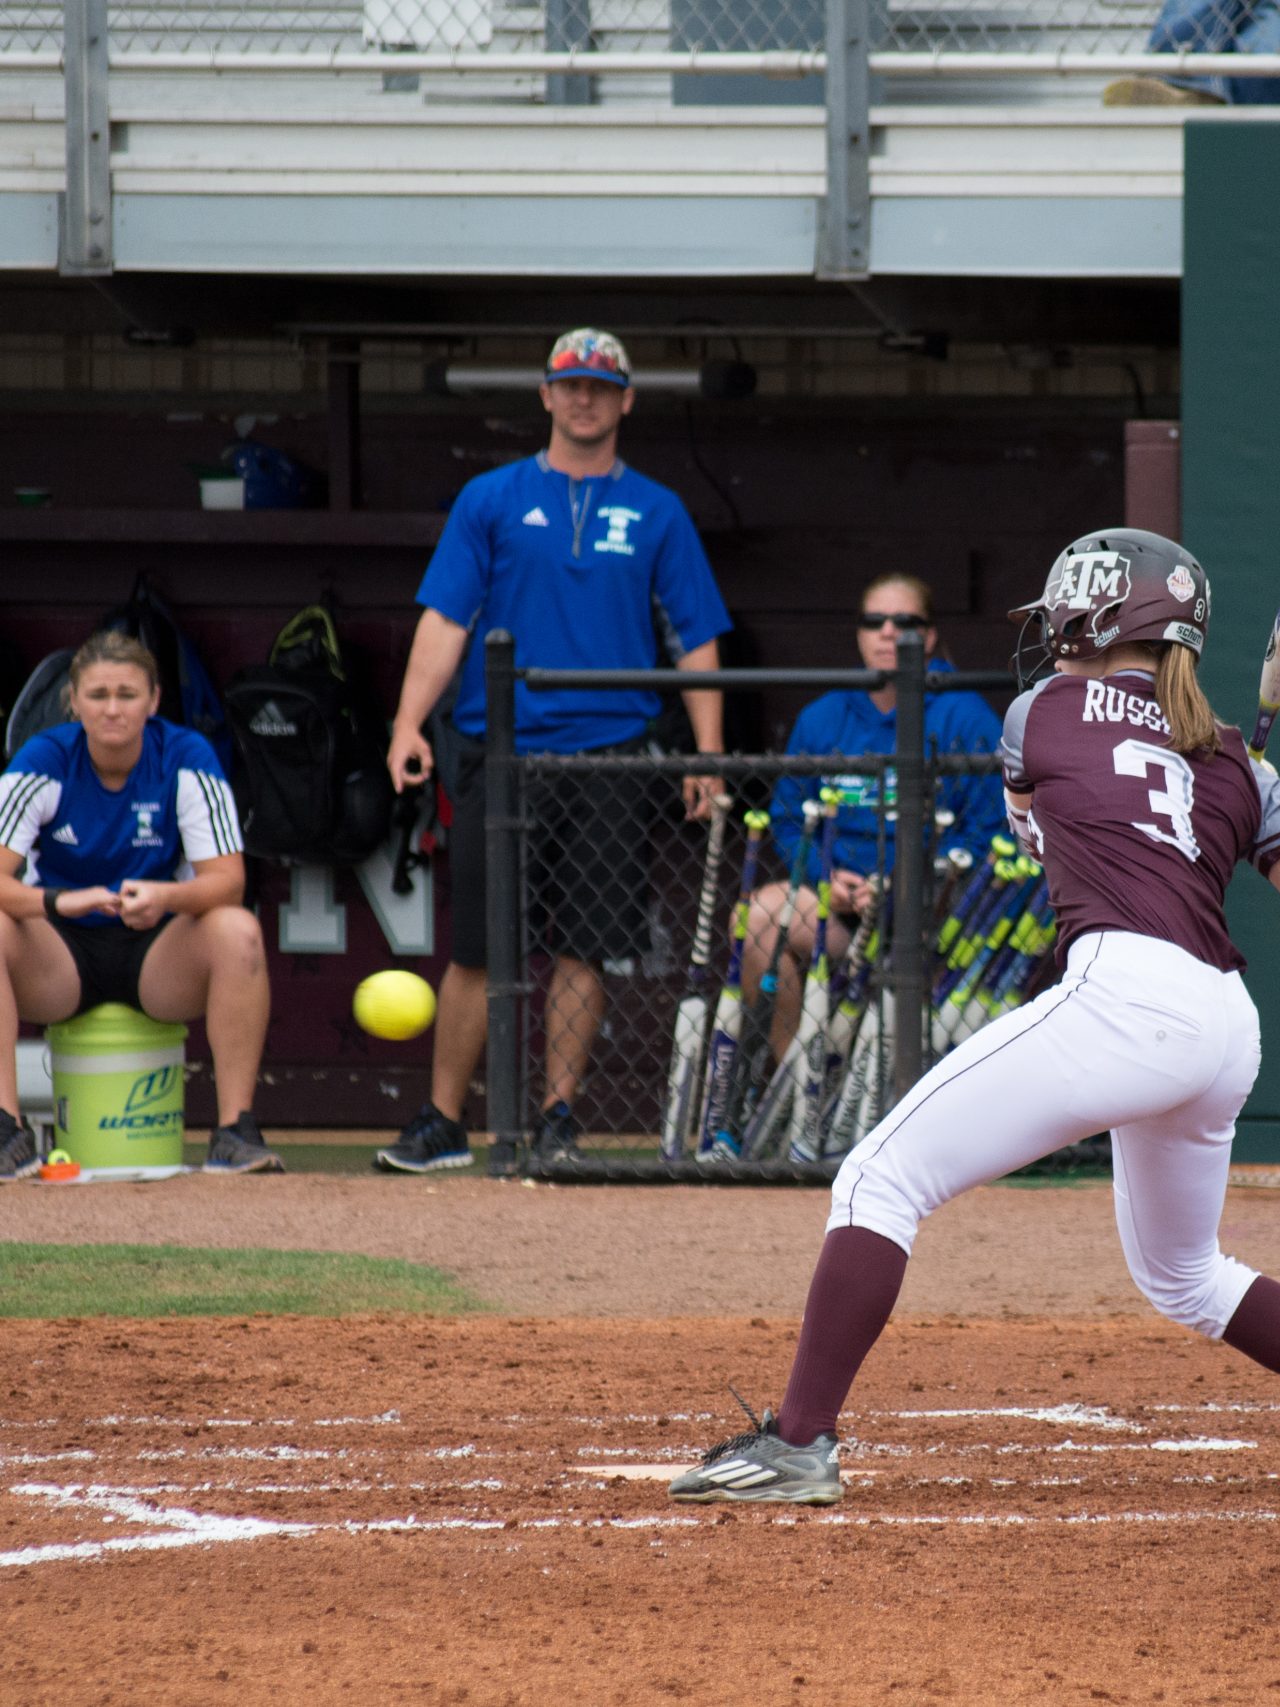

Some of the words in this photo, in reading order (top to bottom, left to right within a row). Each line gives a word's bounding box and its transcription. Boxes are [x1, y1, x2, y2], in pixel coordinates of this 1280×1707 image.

[1194, 599, 1206, 622] 3
[1094, 625, 1120, 647] schutt
[1112, 738, 1201, 862] 3
